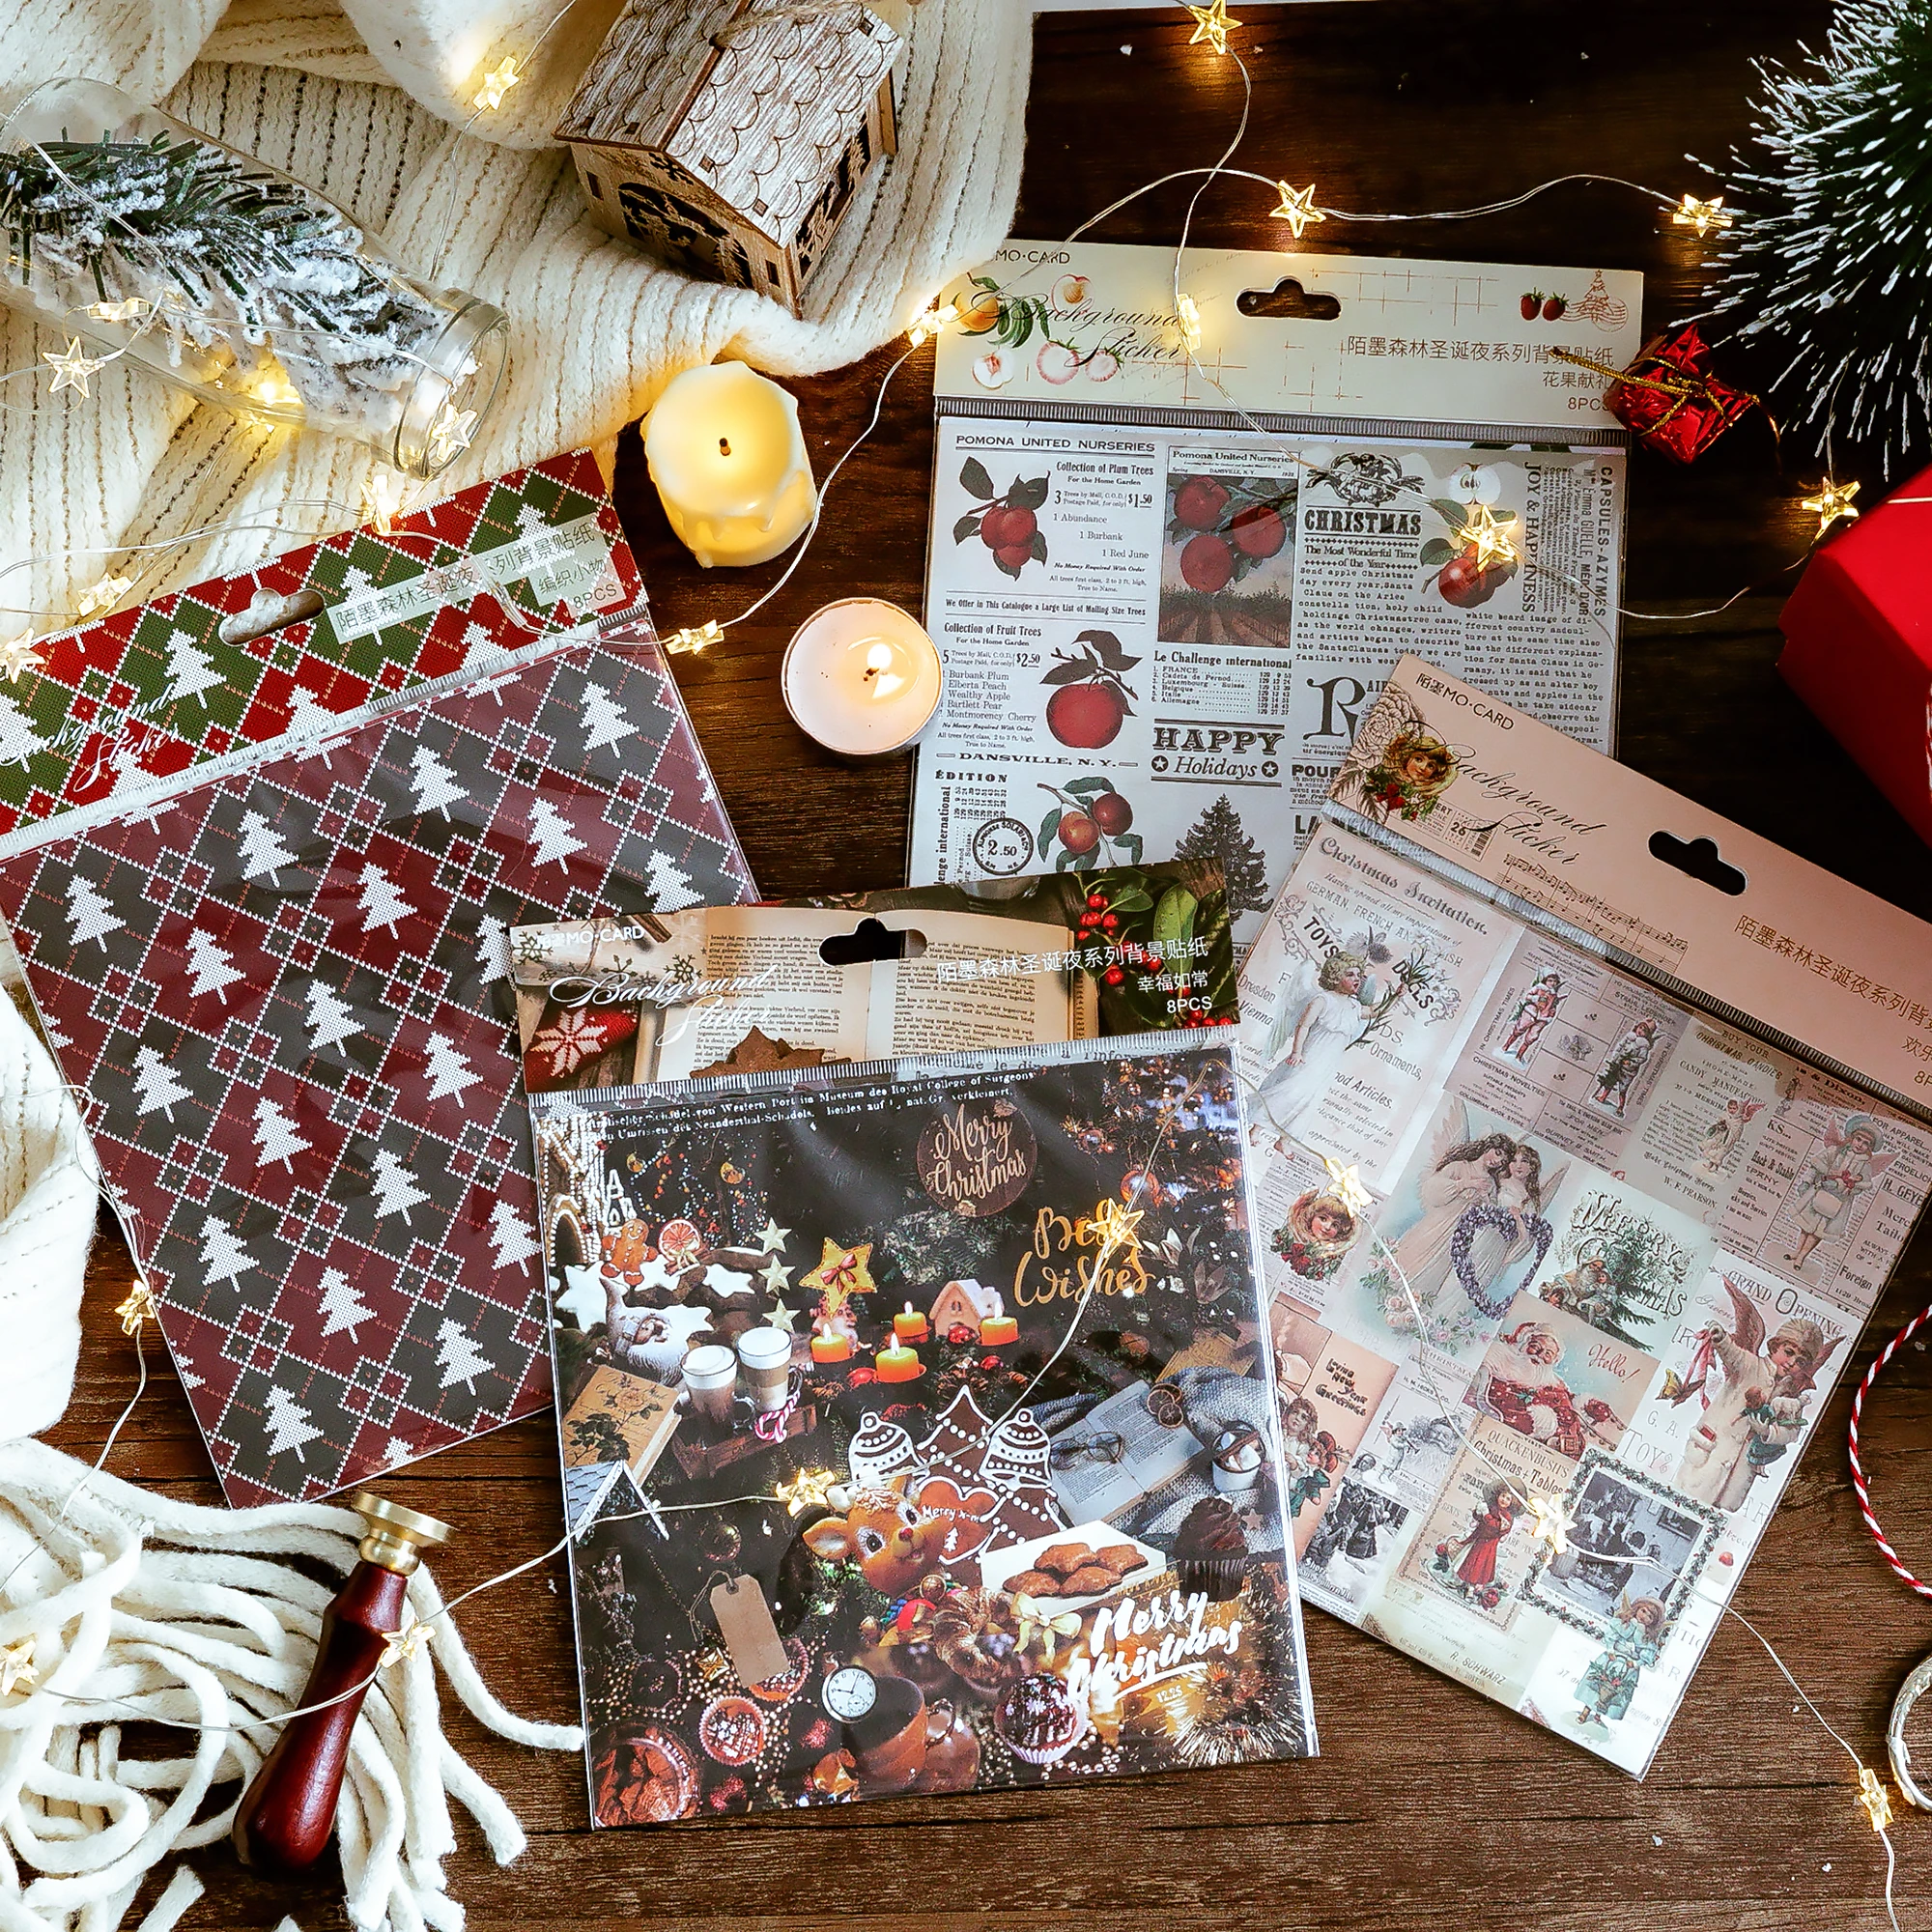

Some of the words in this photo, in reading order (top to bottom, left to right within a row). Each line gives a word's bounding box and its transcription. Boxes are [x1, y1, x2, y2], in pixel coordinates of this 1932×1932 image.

[956, 436, 1015, 446] POMONA
[1022, 437, 1071, 448] UNITED
[1078, 440, 1155, 452] NURSERIES
[1173, 451, 1213, 460] Pomona
[1215, 452, 1247, 462] United
[1249, 454, 1293, 464] Nurseries
[1057, 462, 1096, 472] Collection
[1098, 464, 1106, 473] of
[1109, 464, 1129, 474] Plum
[1131, 466, 1154, 476] Trees
[1524, 462, 1542, 497] JOY
[1127, 493, 1152, 509] $1.50
[1061, 514, 1107, 524] Abundance
[1304, 509, 1422, 536] CHRISTMAS
[1087, 531, 1122, 542] Burbank
[1110, 550, 1126, 558] Red
[1128, 551, 1150, 559] June
[1305, 545, 1321, 554] The
[1324, 546, 1344, 555] Most
[1348, 547, 1392, 557] Wonderful
[1395, 549, 1418, 559] Time
[574, 583, 618, 610] 8PCS
[958, 599, 974, 608] Offer
[1002, 602, 1033, 611] Catalogue
[1041, 603, 1061, 612] Large
[1063, 604, 1074, 612] List
[1086, 605, 1109, 615] Mailing
[1127, 608, 1146, 616] Trees
[1385, 604, 1408, 612] holy
[944, 623, 982, 634] Collection
[985, 623, 994, 635] of
[996, 625, 1016, 636] Fruit
[1019, 626, 1041, 637] Trees
[1016, 653, 1040, 668] $2.50
[1154, 650, 1166, 663] Le
[1171, 651, 1221, 667] Challenge
[949, 669, 985, 679] Burbank
[987, 671, 1009, 681] Plum
[949, 680, 977, 689] Elberta
[949, 690, 988, 700] Wealthy
[991, 692, 1010, 701] Apple
[948, 700, 981, 709] Bartlett
[982, 701, 1003, 710] Pear
[947, 709, 1004, 722] Montmorency
[1008, 712, 1037, 723] Cherry
[1152, 727, 1285, 755] HAPPY
[959, 753, 1072, 766] DANSVILLE,
[1078, 758, 1094, 767] N.
[1174, 756, 1258, 780] Holidays
[935, 769, 1008, 782] ÉDITION
[1401, 721, 1607, 837] Background
[988, 839, 1017, 856] 2.50
[1306, 881, 1350, 912] GERMAN,
[1353, 905, 1393, 931] FRENCH
[1303, 916, 1341, 959] TOYS
[549, 964, 779, 1009] Background
[1137, 973, 1209, 993] 幸福如常
[1166, 996, 1212, 1015] 8PCS
[1721, 1030, 1742, 1043] BUY
[1744, 1041, 1770, 1059] YOUR
[1370, 1041, 1422, 1081] Ornaments,
[970, 1075, 981, 1086] of
[1353, 1080, 1393, 1109] Articles.
[933, 1103, 1012, 1162] Merry
[926, 1147, 1026, 1201] Christmas
[1838, 1264, 1873, 1292] Foreign
[1586, 1343, 1642, 1384] Hello!
[922, 1504, 956, 1521] Merry
[1090, 1590, 1208, 1657] Merry
